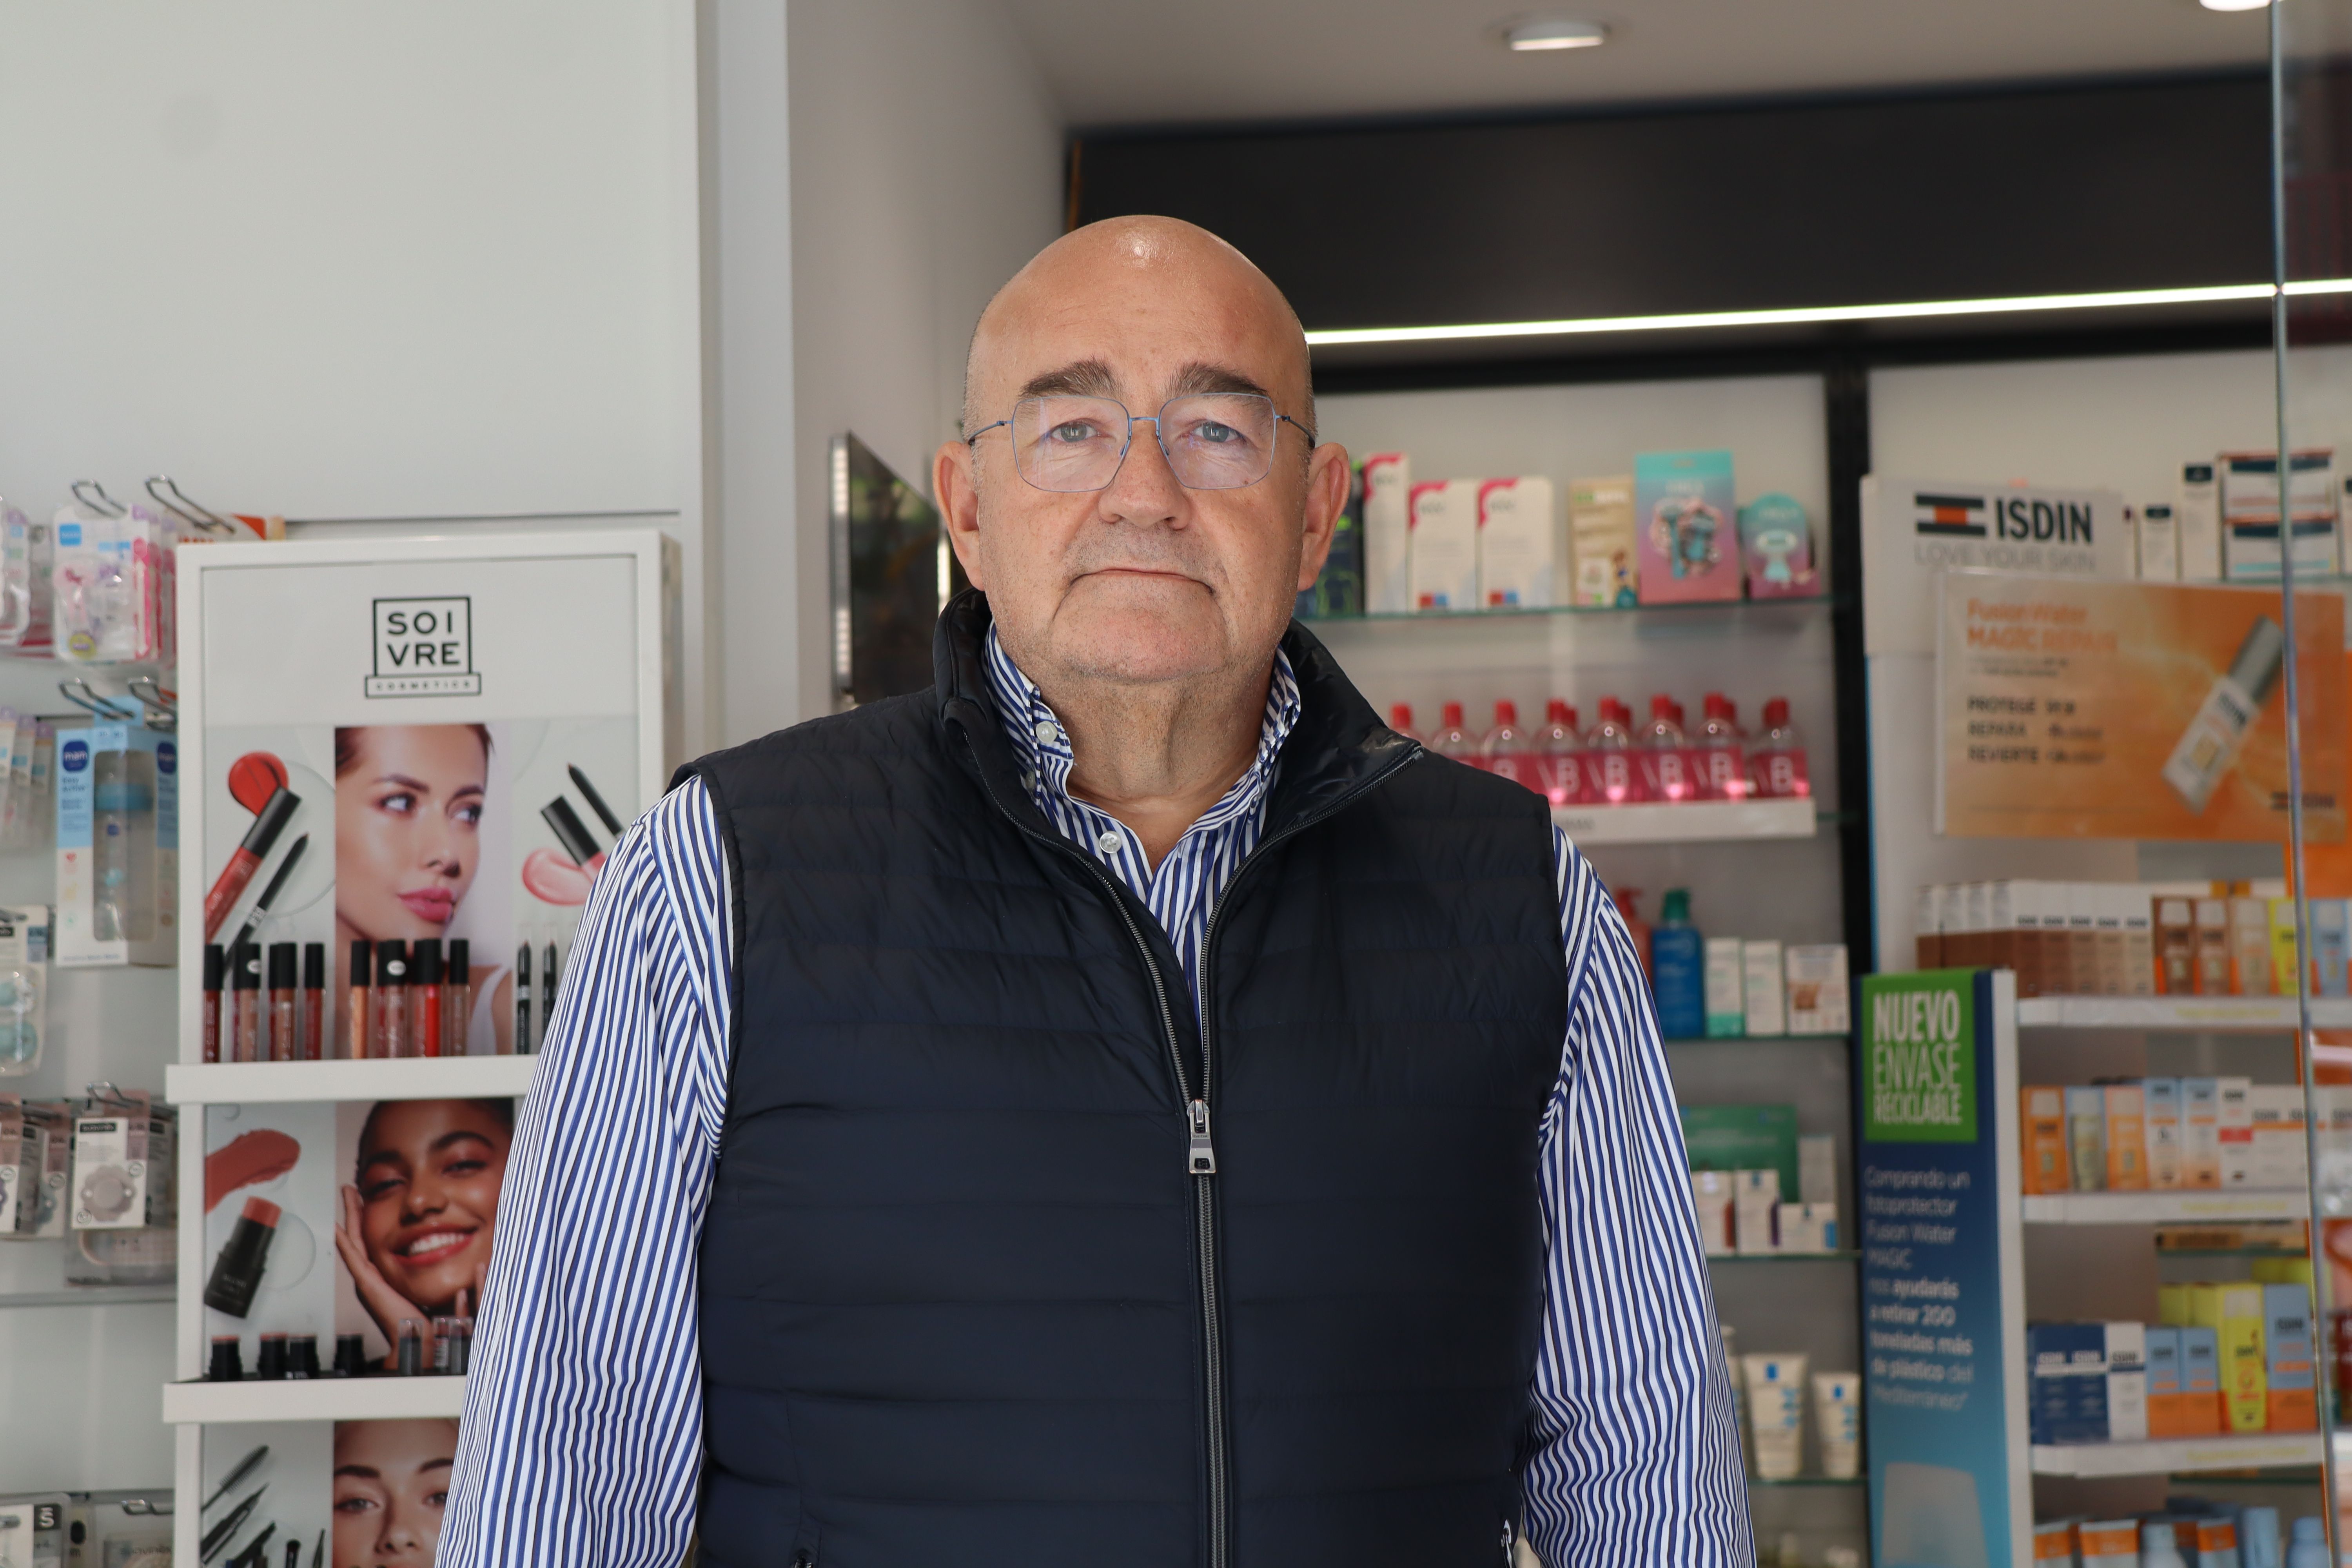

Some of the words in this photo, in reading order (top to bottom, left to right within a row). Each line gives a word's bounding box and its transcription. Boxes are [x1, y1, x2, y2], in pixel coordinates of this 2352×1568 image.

[1996, 497, 2092, 543] ISDIN
[1915, 541, 1971, 567] LOVE
[1980, 543, 2042, 570] YOUR
[2048, 546, 2096, 572] SKIN
[388, 610, 452, 635] SOI
[387, 642, 460, 666] VRE
[64, 750, 87, 761] mam
[1873, 990, 1961, 1042] NUEVO
[1873, 1043, 1961, 1088] ENVASE
[1873, 1089, 1962, 1124] RECICLABLE
[1864, 1166, 1946, 1190] Comprando
[1948, 1171, 1971, 1189] un
[1922, 1305, 1956, 1327] 200
